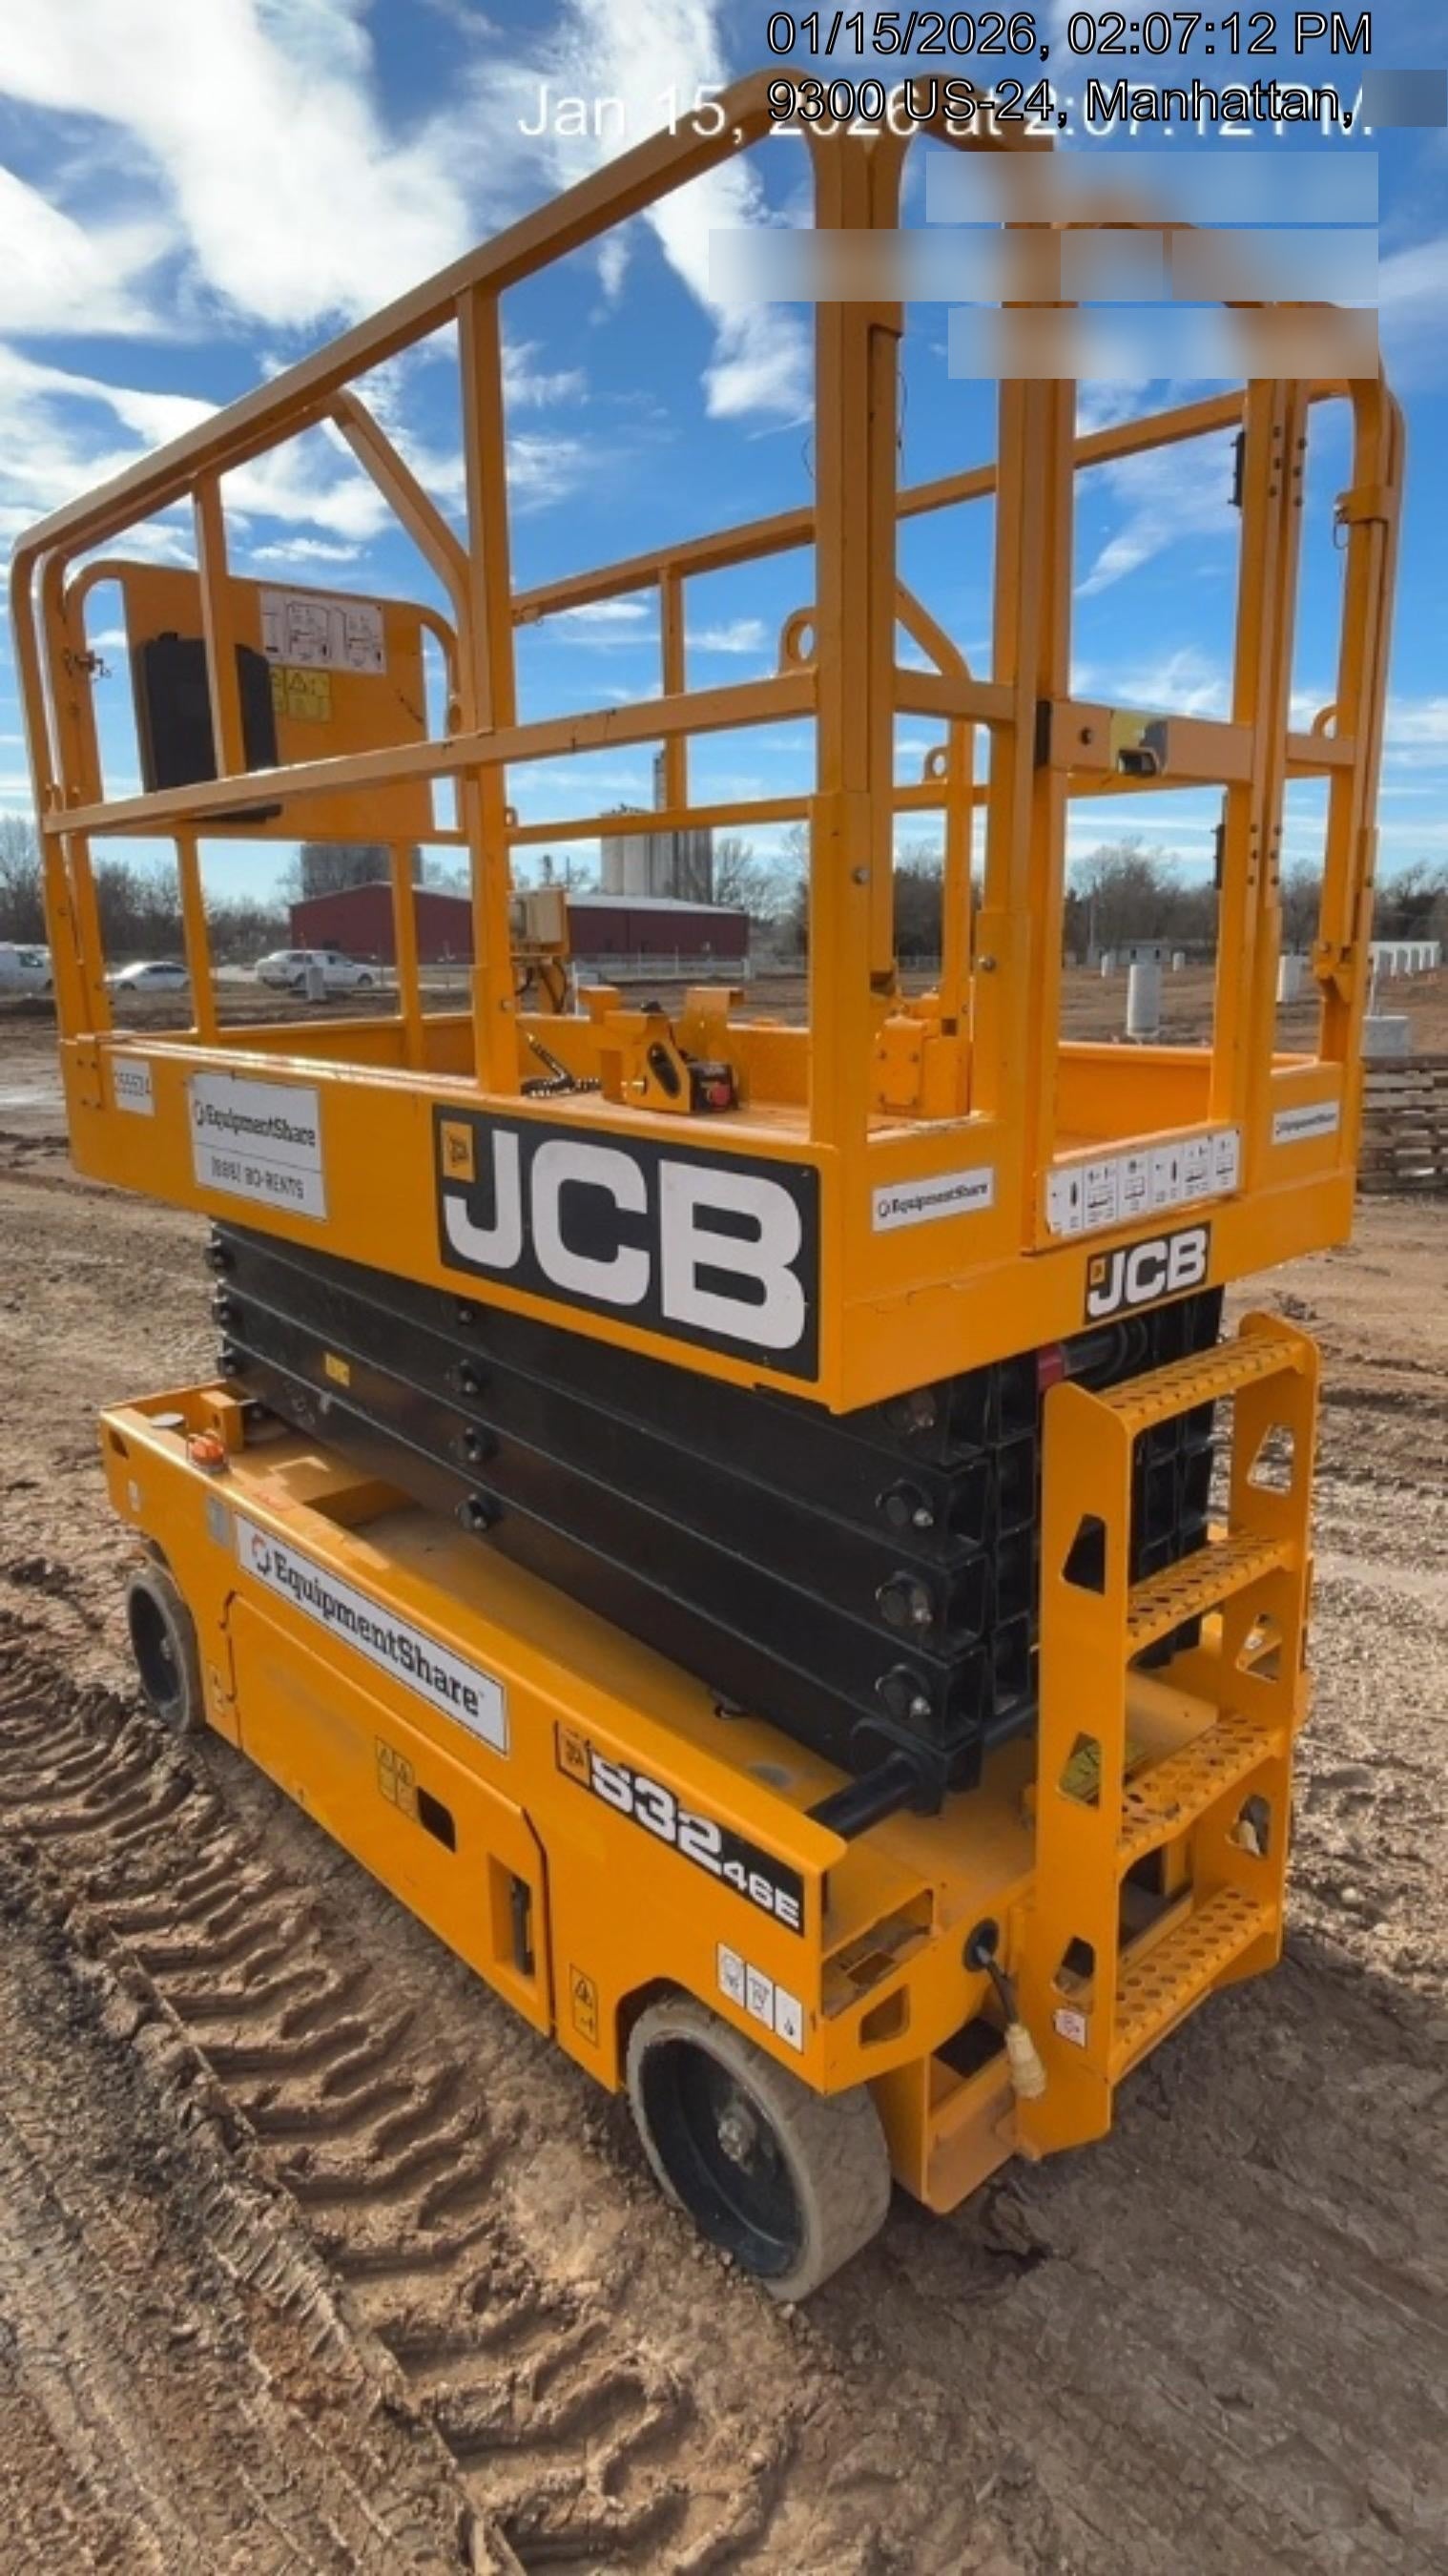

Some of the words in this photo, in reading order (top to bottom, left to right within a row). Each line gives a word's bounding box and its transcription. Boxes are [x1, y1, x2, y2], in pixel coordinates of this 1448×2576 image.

[205, 1104, 316, 1148] EquipmentShare
[444, 1130, 806, 1350] JCB
[1087, 1228, 1207, 1318] JCB
[273, 1548, 480, 1717] EquipmentShare
